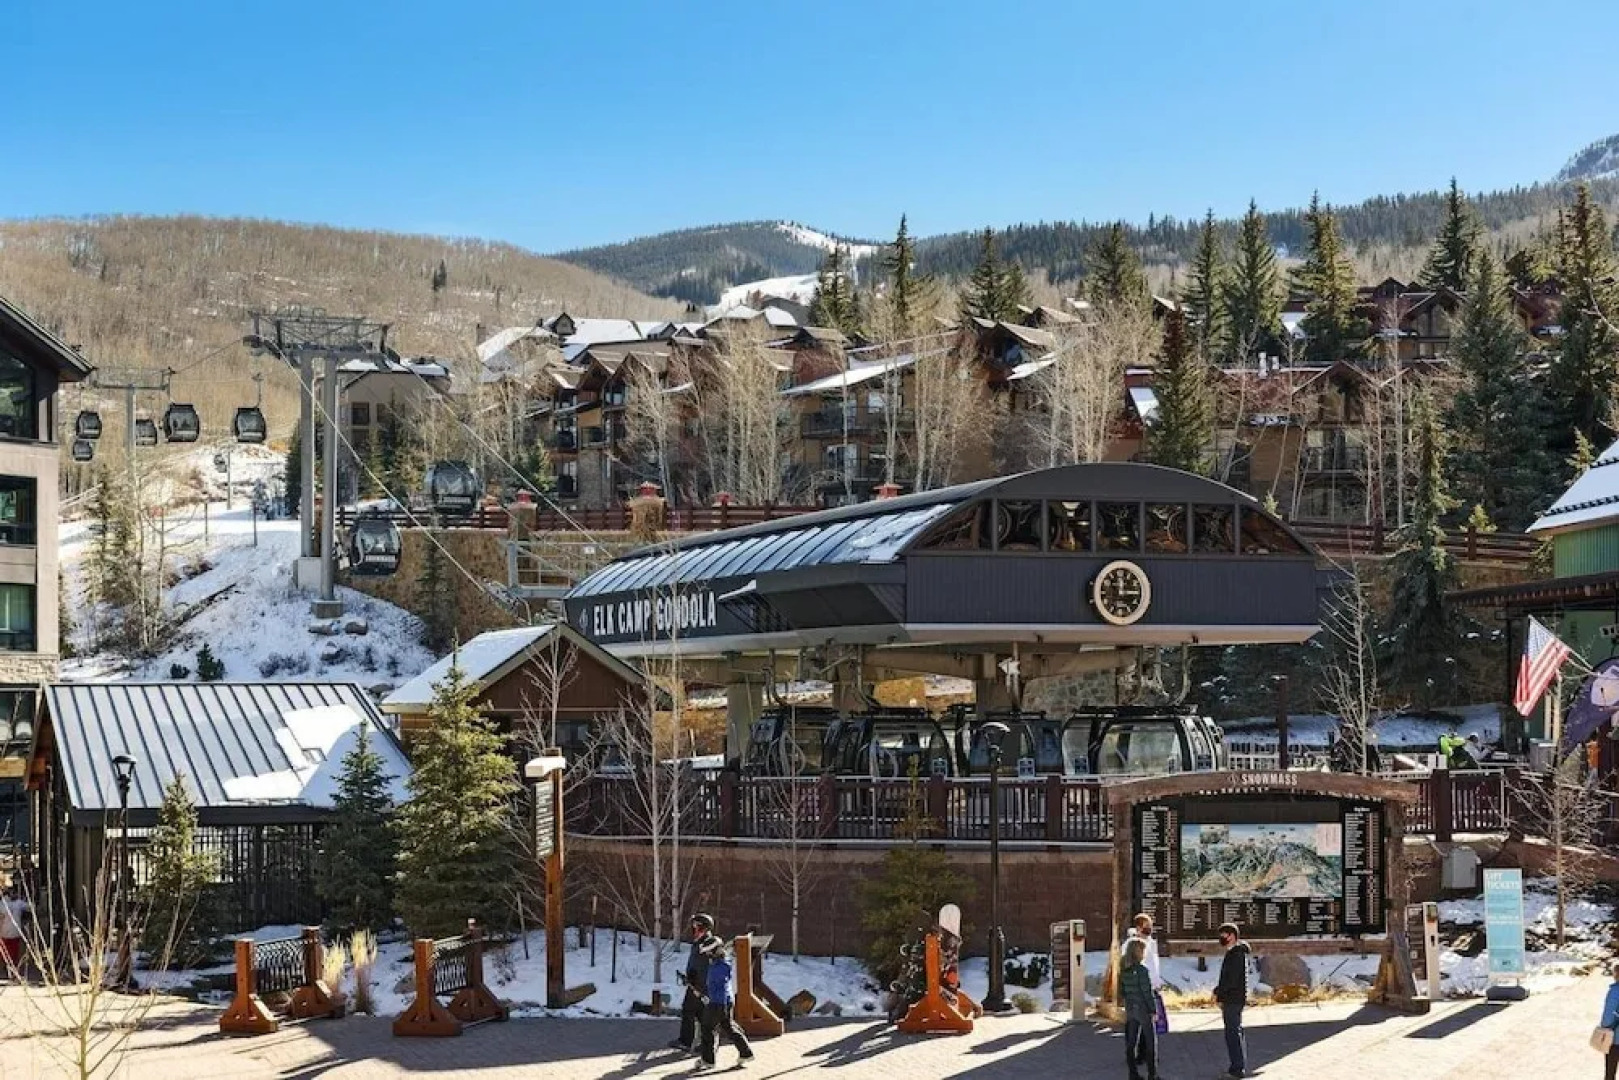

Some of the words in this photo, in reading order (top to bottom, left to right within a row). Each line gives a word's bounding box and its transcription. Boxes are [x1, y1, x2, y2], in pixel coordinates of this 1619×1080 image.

[593, 603, 615, 636] ELK
[618, 599, 650, 634] CAMP
[1241, 773, 1298, 786] SNOWMASS
